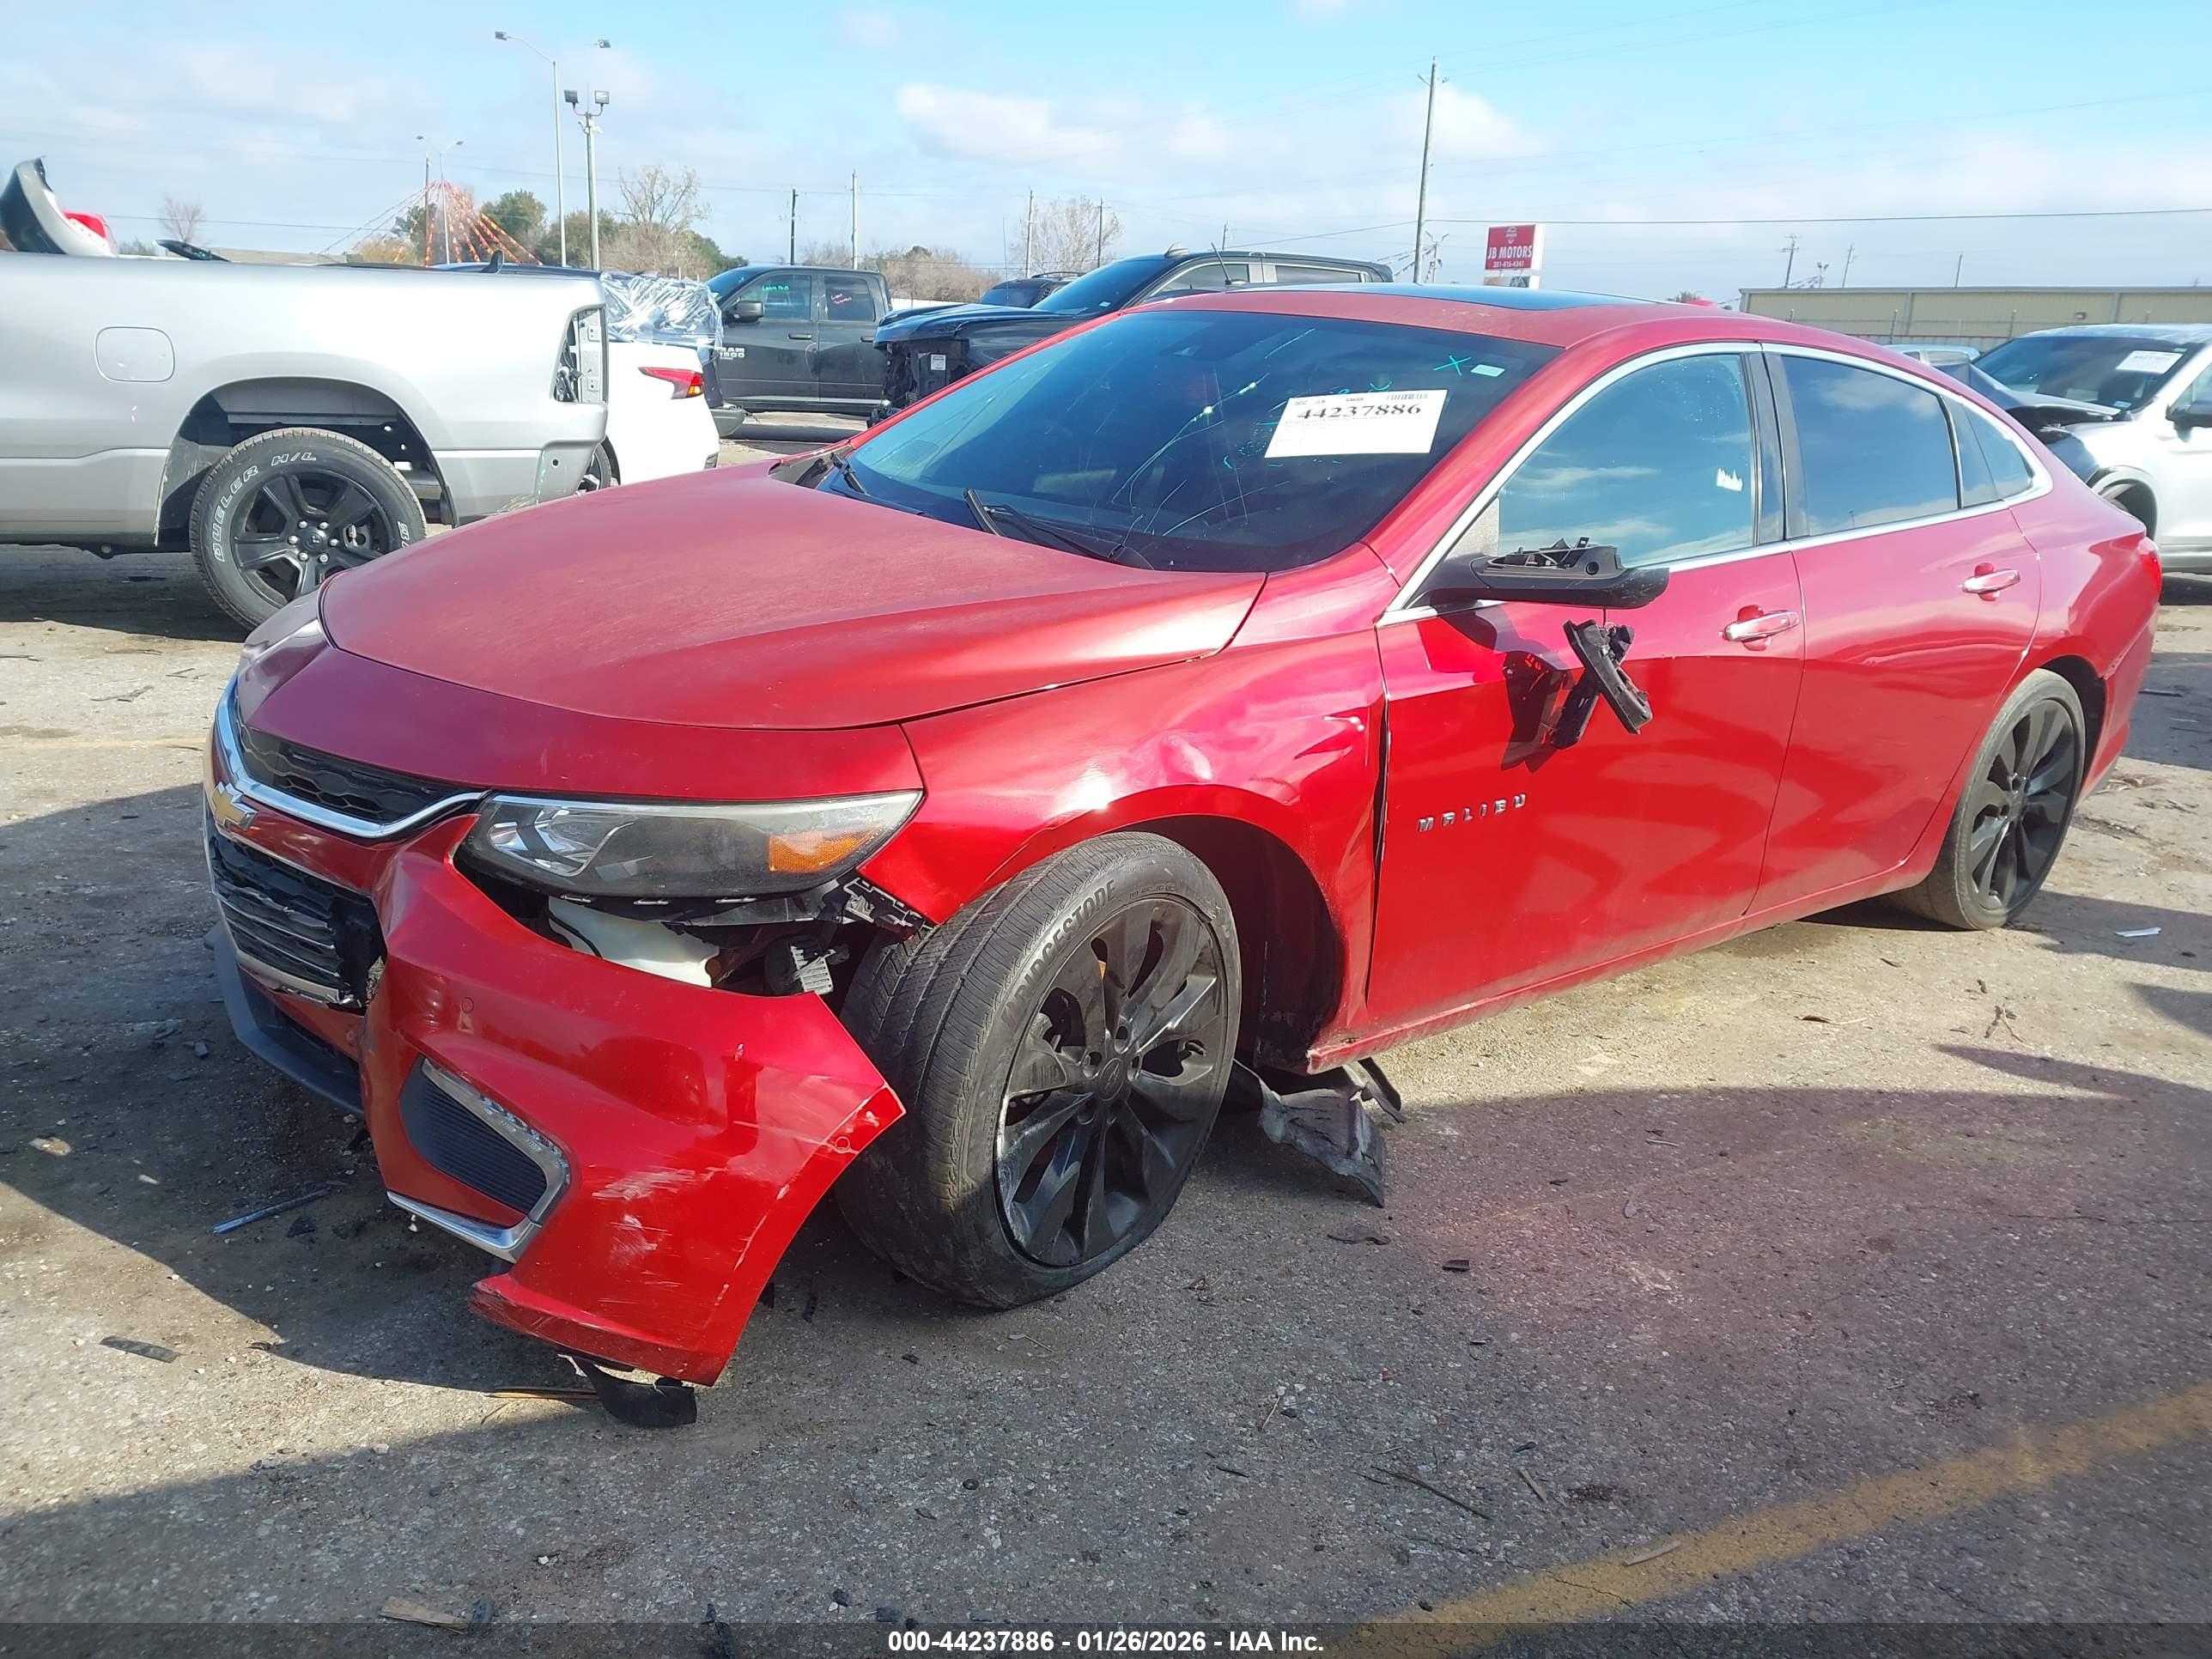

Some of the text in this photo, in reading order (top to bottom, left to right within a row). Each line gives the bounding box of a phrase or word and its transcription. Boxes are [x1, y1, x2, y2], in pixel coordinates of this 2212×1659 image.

[1487, 246, 1533, 259] JB MOTORS
[1297, 404, 1421, 419] 44237886
[211, 452, 317, 562] DUELER H/L
[1418, 793, 1527, 832] MALIBU
[1001, 878, 1116, 1026] BRIDGESTONE
